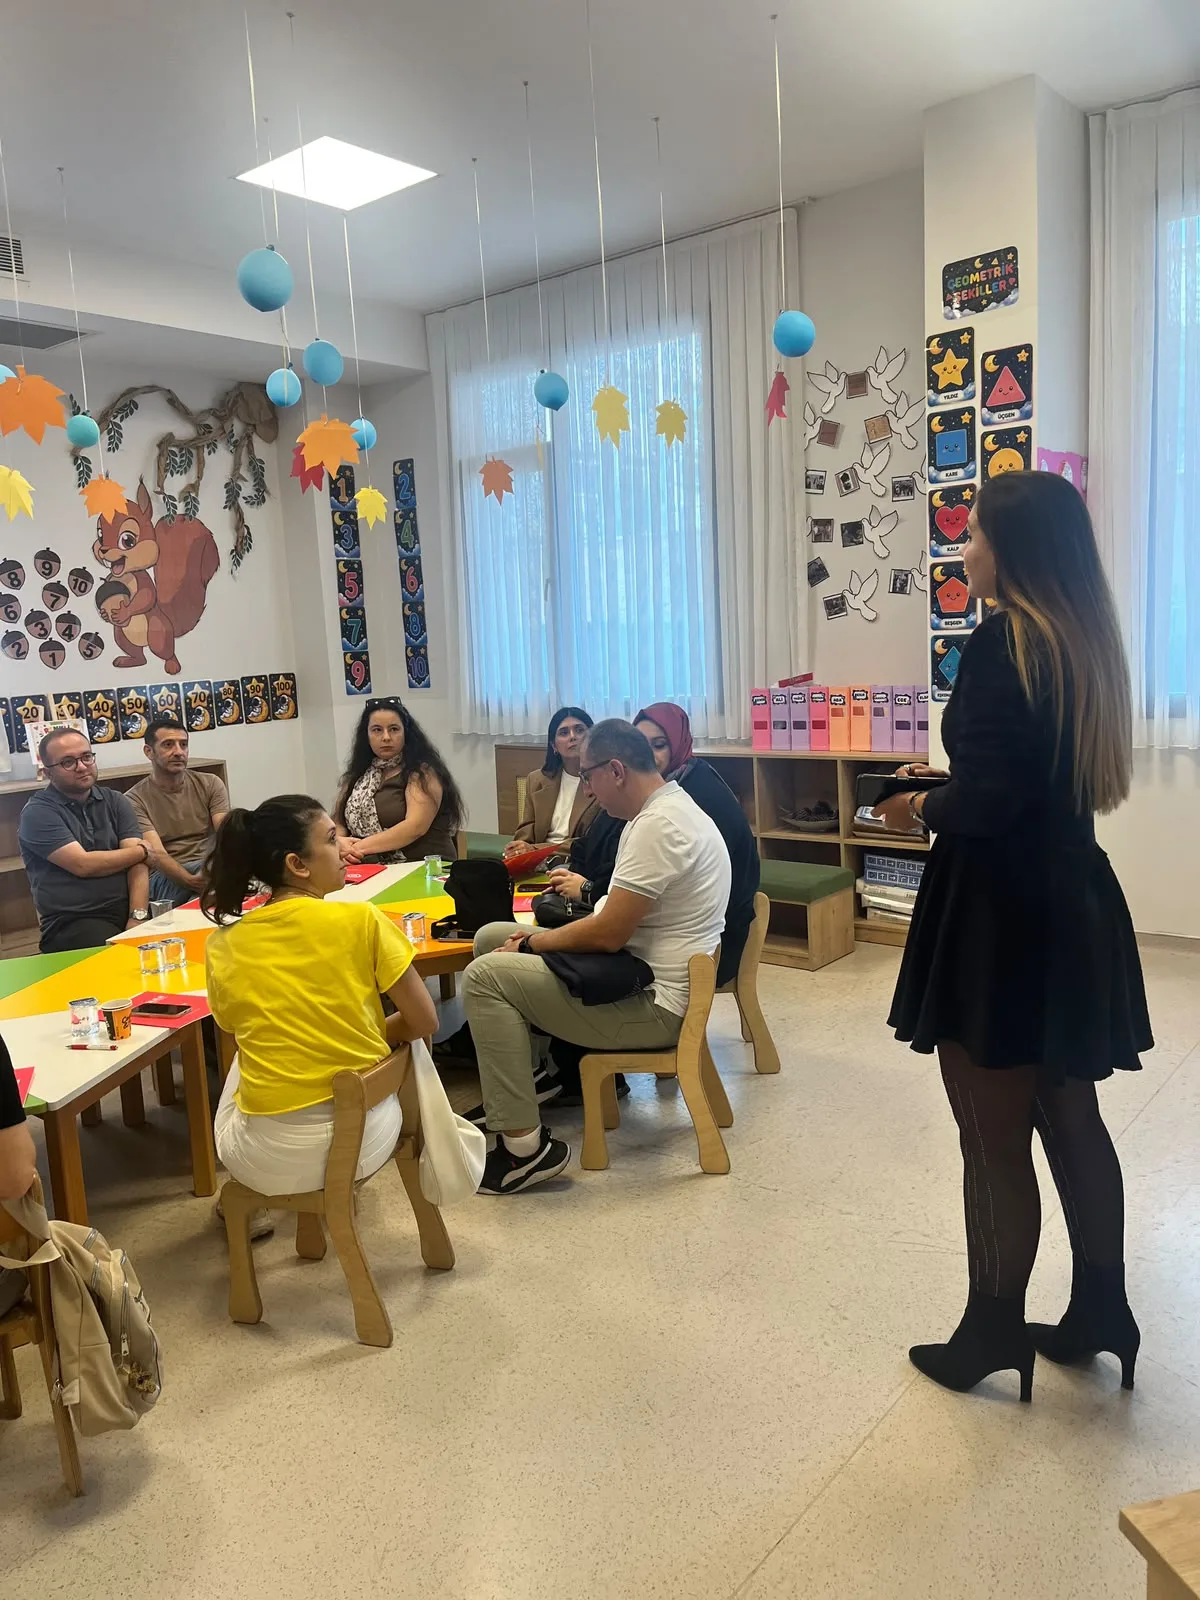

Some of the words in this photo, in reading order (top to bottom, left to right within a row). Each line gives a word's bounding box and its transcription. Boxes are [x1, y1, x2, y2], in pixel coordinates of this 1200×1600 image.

[947, 262, 1014, 290] GEOMETRİK
[337, 477, 349, 503] 1
[399, 474, 412, 500] 2
[340, 524, 354, 549] 3
[401, 520, 414, 548] 4
[41, 561, 53, 577] 9
[7, 572, 21, 588] 8
[72, 578, 88, 594] 10
[345, 572, 359, 598] 5
[406, 567, 418, 592] 6
[50, 593, 61, 609] 7
[4, 605, 18, 620] 6
[34, 622, 48, 638] 3
[61, 625, 74, 640] 4
[347, 619, 361, 644] 7
[409, 613, 421, 636] 8
[11, 642, 27, 658] 2
[83, 643, 97, 658] 5
[48, 652, 57, 667] 1
[351, 661, 366, 687] 9
[410, 657, 427, 679] 10
[222, 687, 233, 696] 80
[250, 684, 261, 694] 90
[276, 682, 290, 692] 100
[127, 698, 143, 710] 50
[159, 694, 174, 707] 60
[191, 691, 206, 703] 70
[22, 706, 39, 719] 20
[93, 701, 110, 713] 40
